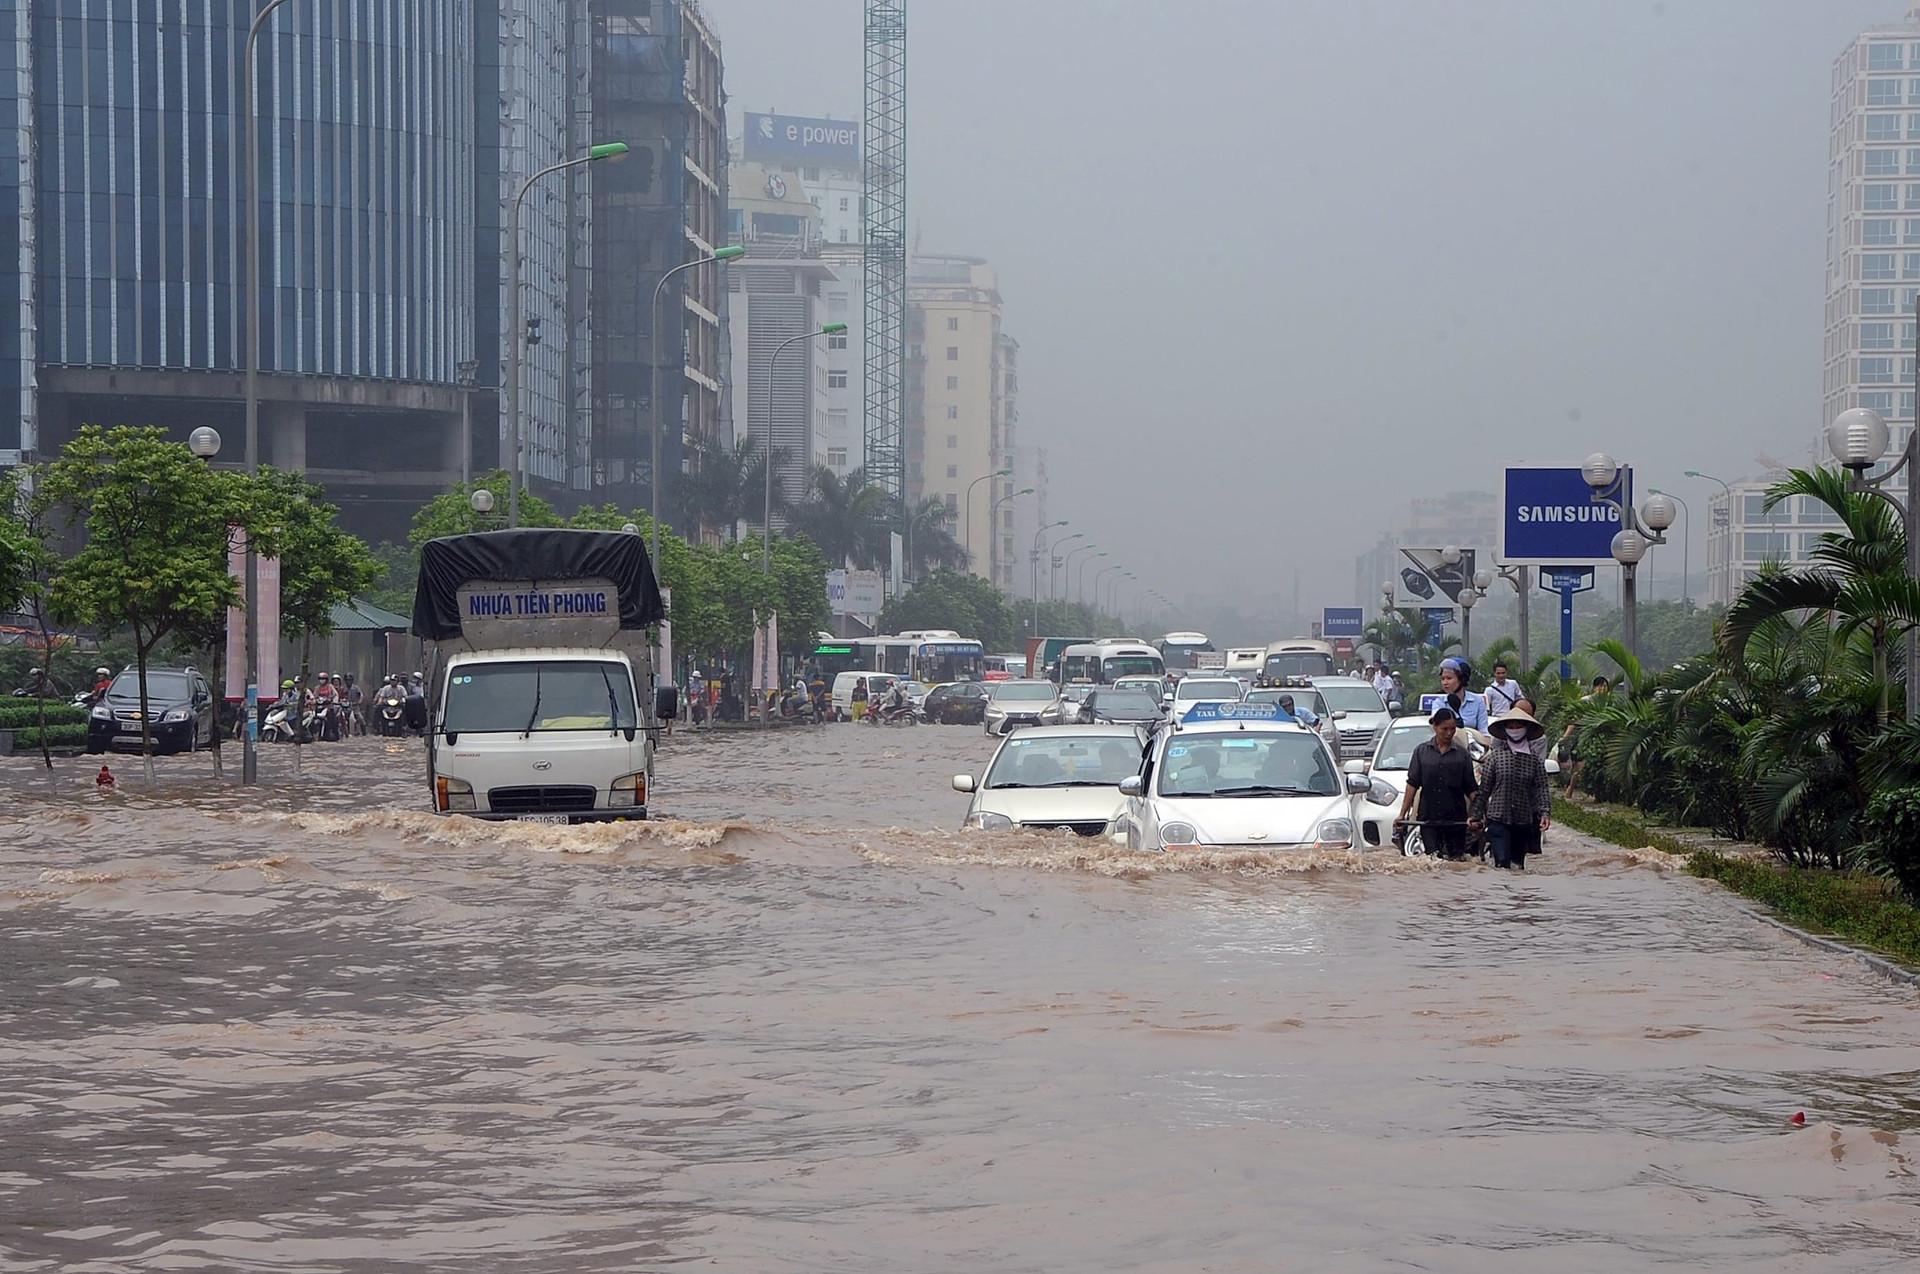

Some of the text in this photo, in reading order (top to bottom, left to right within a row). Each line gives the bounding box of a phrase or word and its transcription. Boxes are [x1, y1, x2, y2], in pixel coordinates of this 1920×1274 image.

[786, 124, 857, 146] e power
[1518, 505, 1620, 522] SAMSUNG
[553, 592, 606, 614] PHONG
